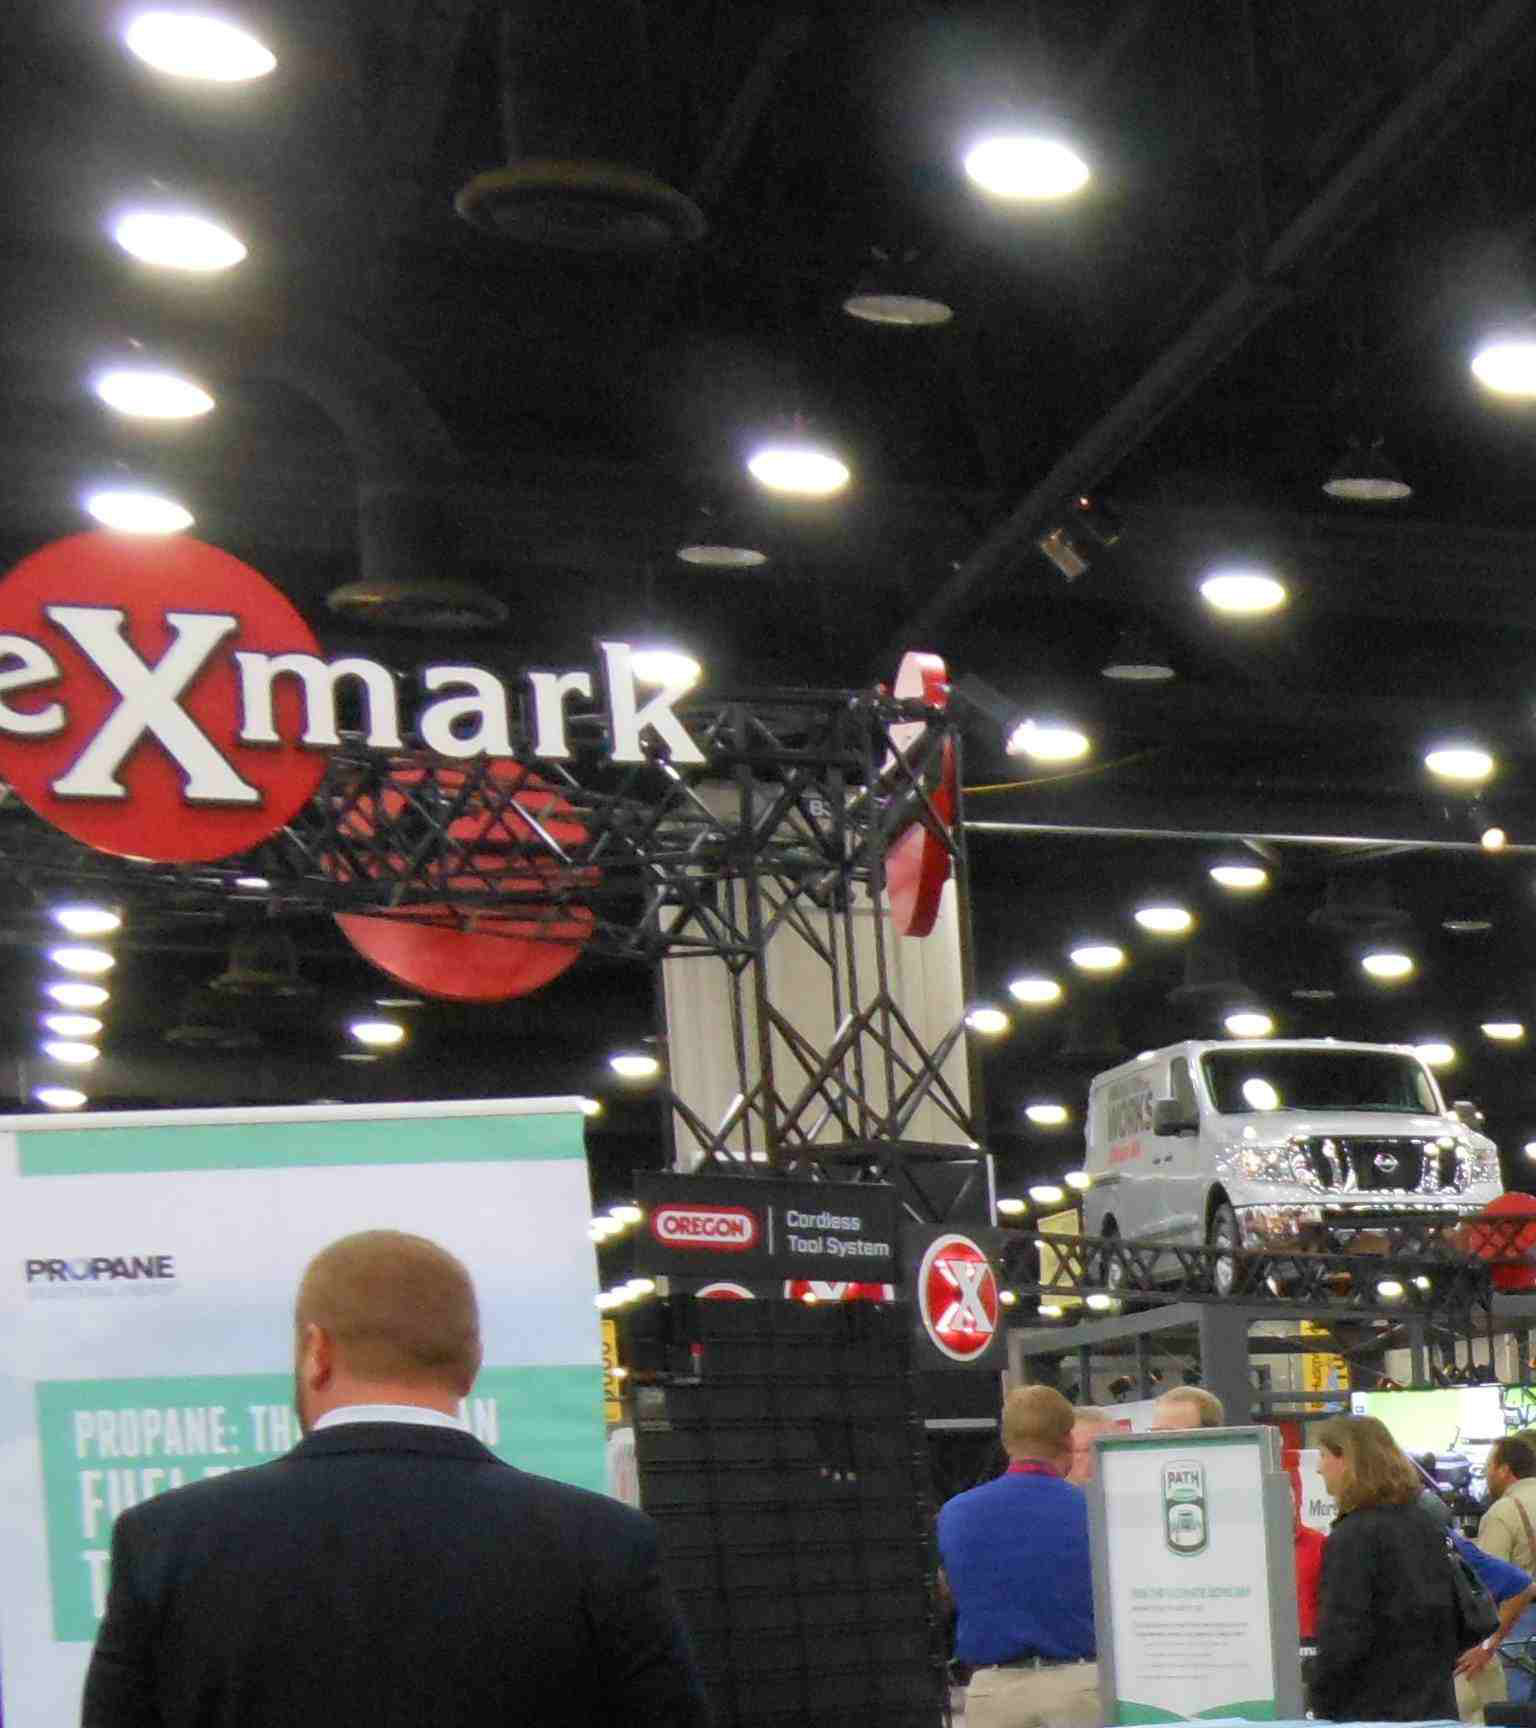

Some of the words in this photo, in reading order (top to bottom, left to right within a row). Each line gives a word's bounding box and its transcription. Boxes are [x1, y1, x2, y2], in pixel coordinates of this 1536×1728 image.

[0, 604, 707, 803] eXmark
[663, 1215, 746, 1237] OREGON
[786, 1209, 861, 1232] Cordless
[787, 1234, 824, 1254] Tool
[826, 1236, 890, 1258] System
[26, 1254, 176, 1283] PROPANE
[74, 1406, 239, 1458] PROPANE:
[248, 1404, 303, 1454] TH
